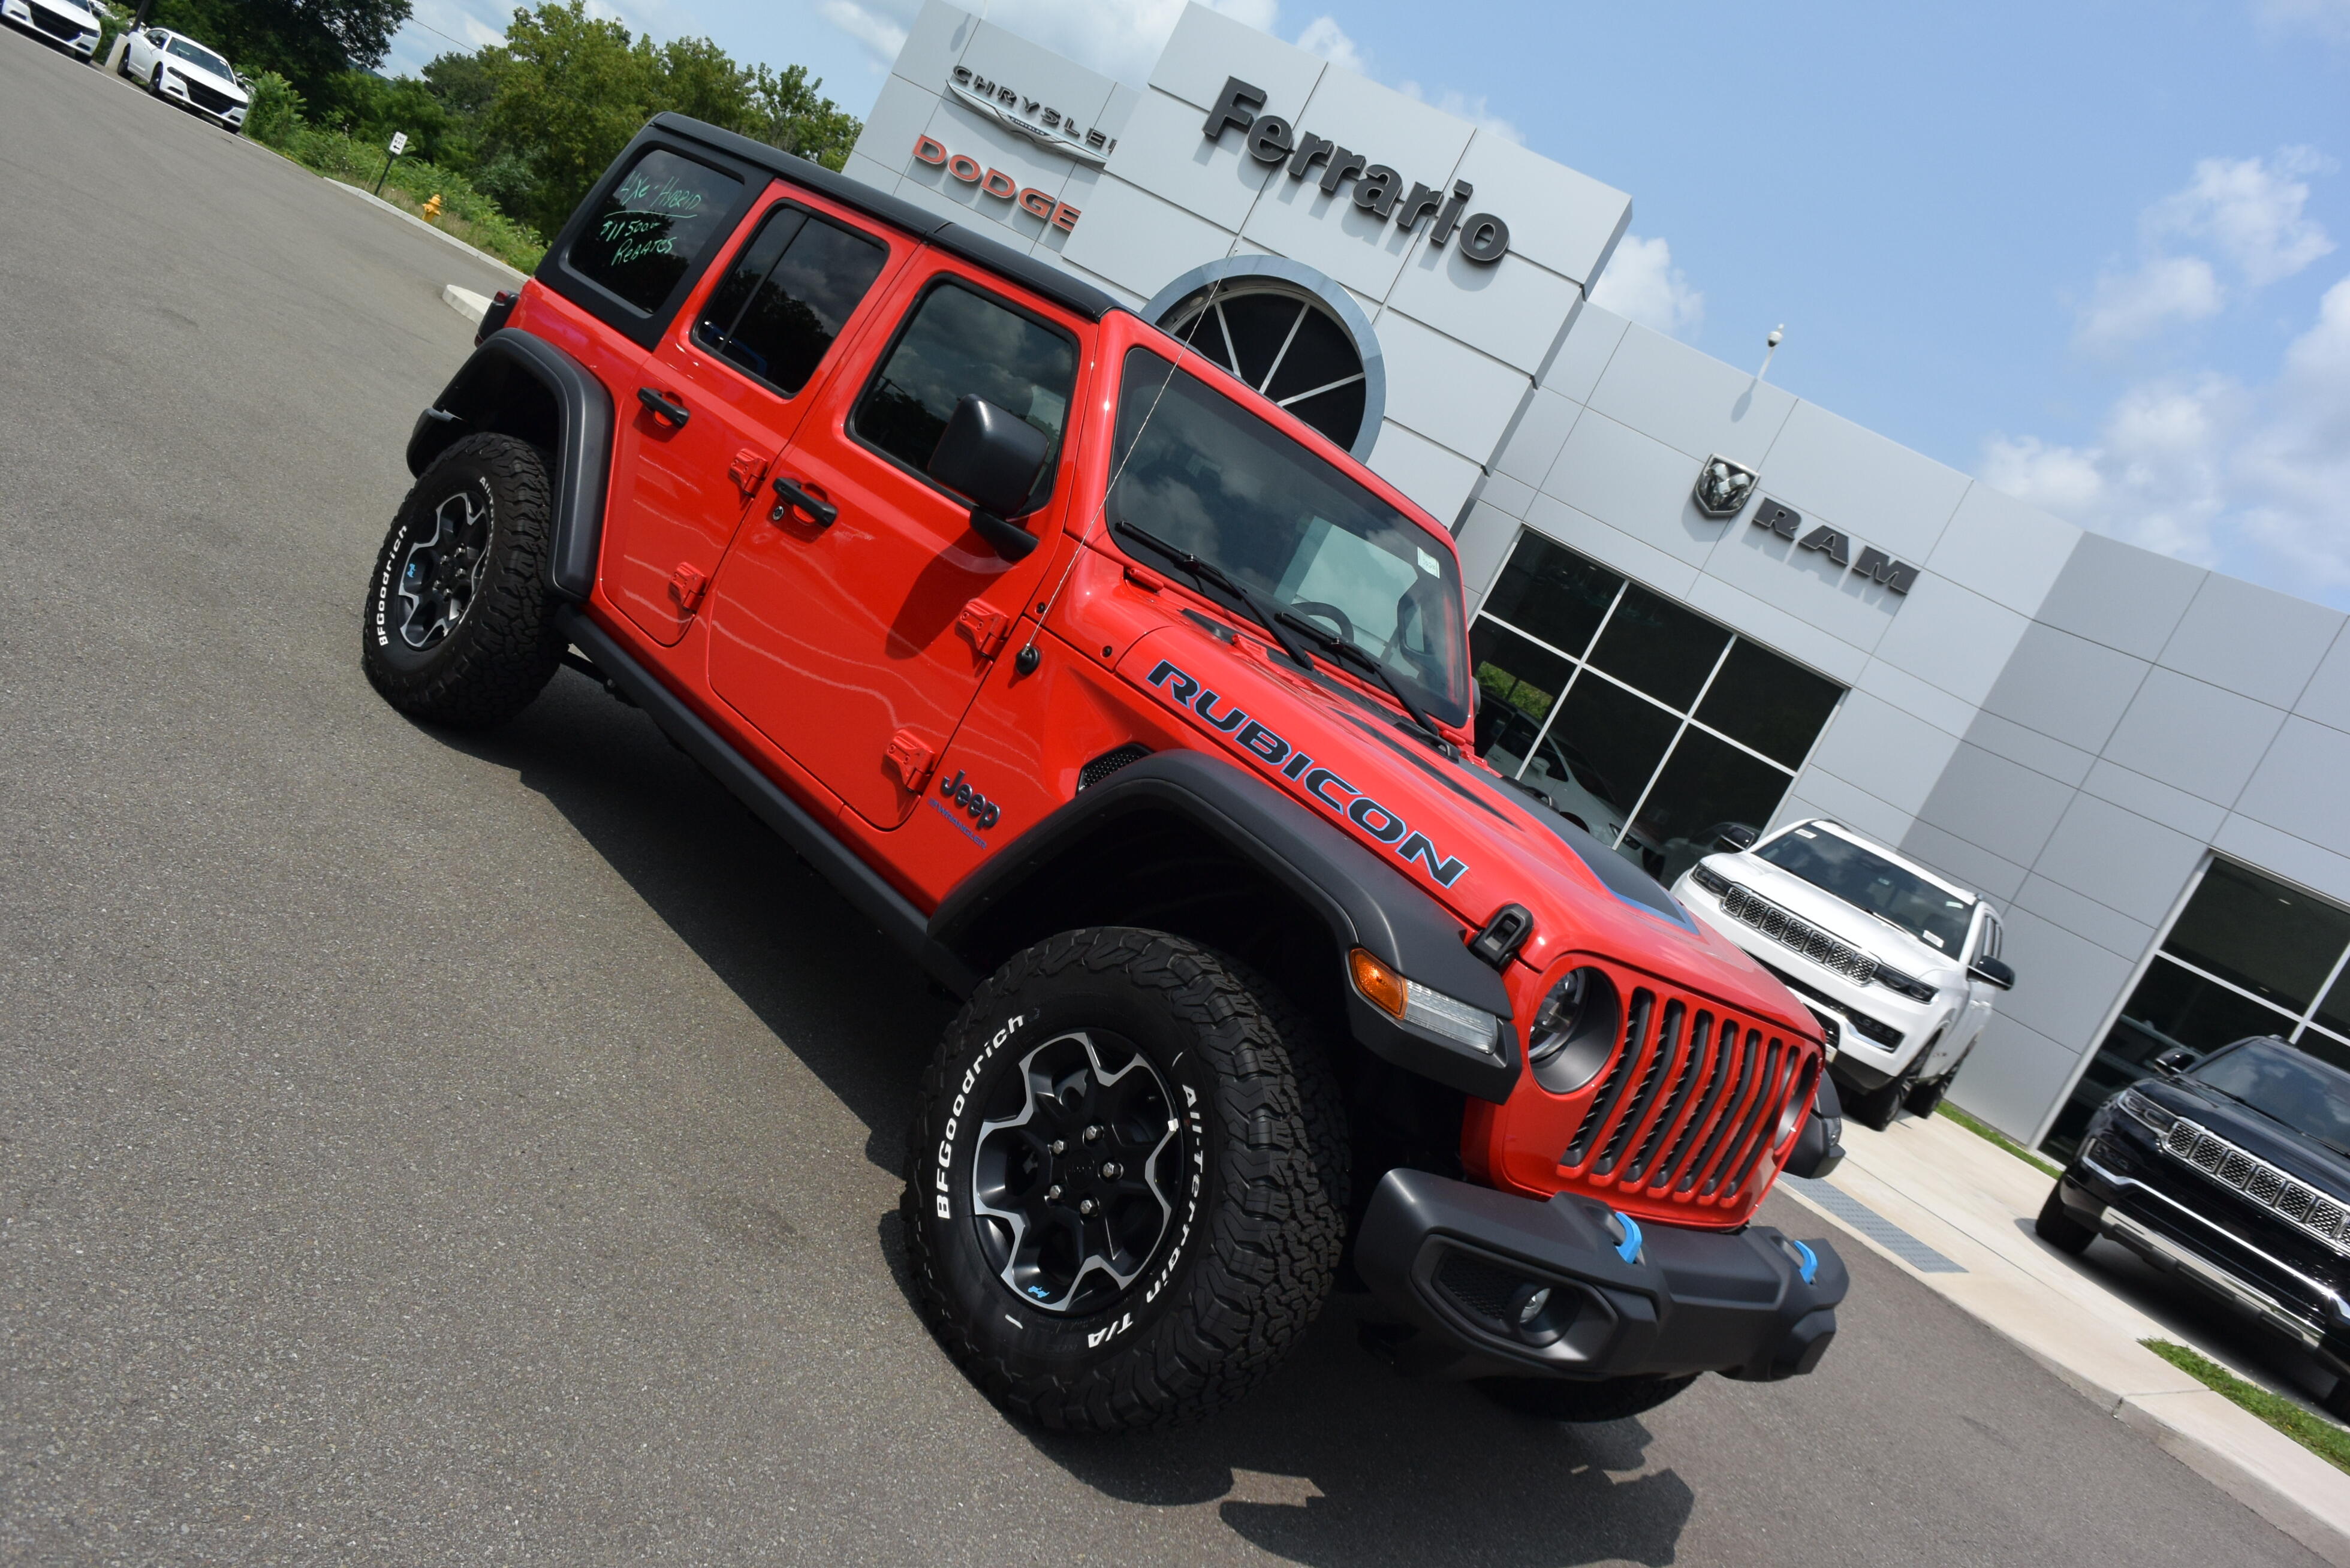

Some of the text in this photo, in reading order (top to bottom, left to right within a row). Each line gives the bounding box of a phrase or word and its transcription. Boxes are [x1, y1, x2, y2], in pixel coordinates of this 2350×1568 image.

[912, 134, 1081, 233] DODGE
[1201, 75, 1510, 262] Ferrario
[376, 525, 408, 646] BFGoodrich
[1752, 497, 1920, 595] RAM
[937, 803, 987, 849] WRANGLER
[941, 769, 1001, 830] Jeep
[1145, 659, 1469, 889] RUBICON
[936, 1014, 1024, 1219] BFGoodrich
[1087, 1084, 1205, 1349] All-Terrain T/A
